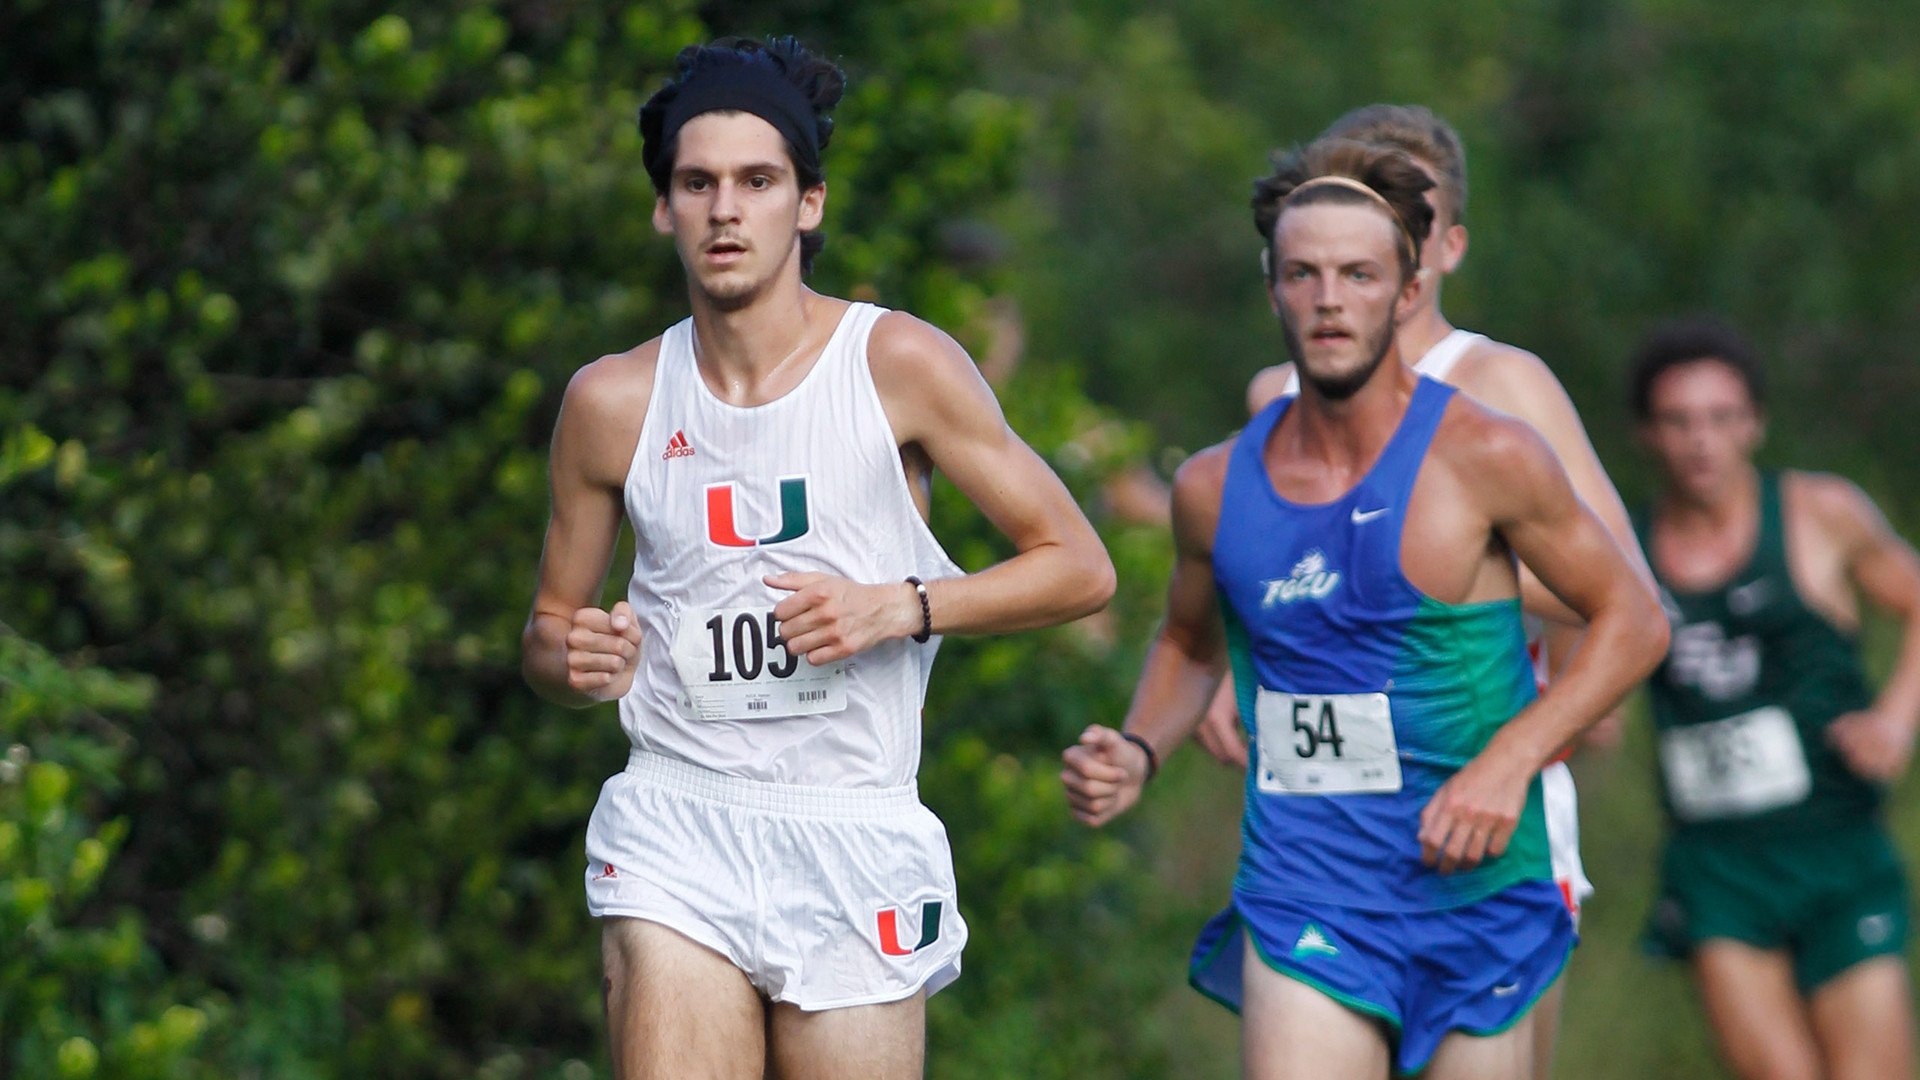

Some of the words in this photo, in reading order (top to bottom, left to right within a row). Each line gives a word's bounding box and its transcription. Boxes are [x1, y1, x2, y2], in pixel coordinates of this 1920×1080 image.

[662, 446, 696, 460] adidas
[704, 476, 811, 549] U
[706, 611, 799, 682] 105
[1293, 699, 1345, 759] 54
[876, 901, 944, 957] U
